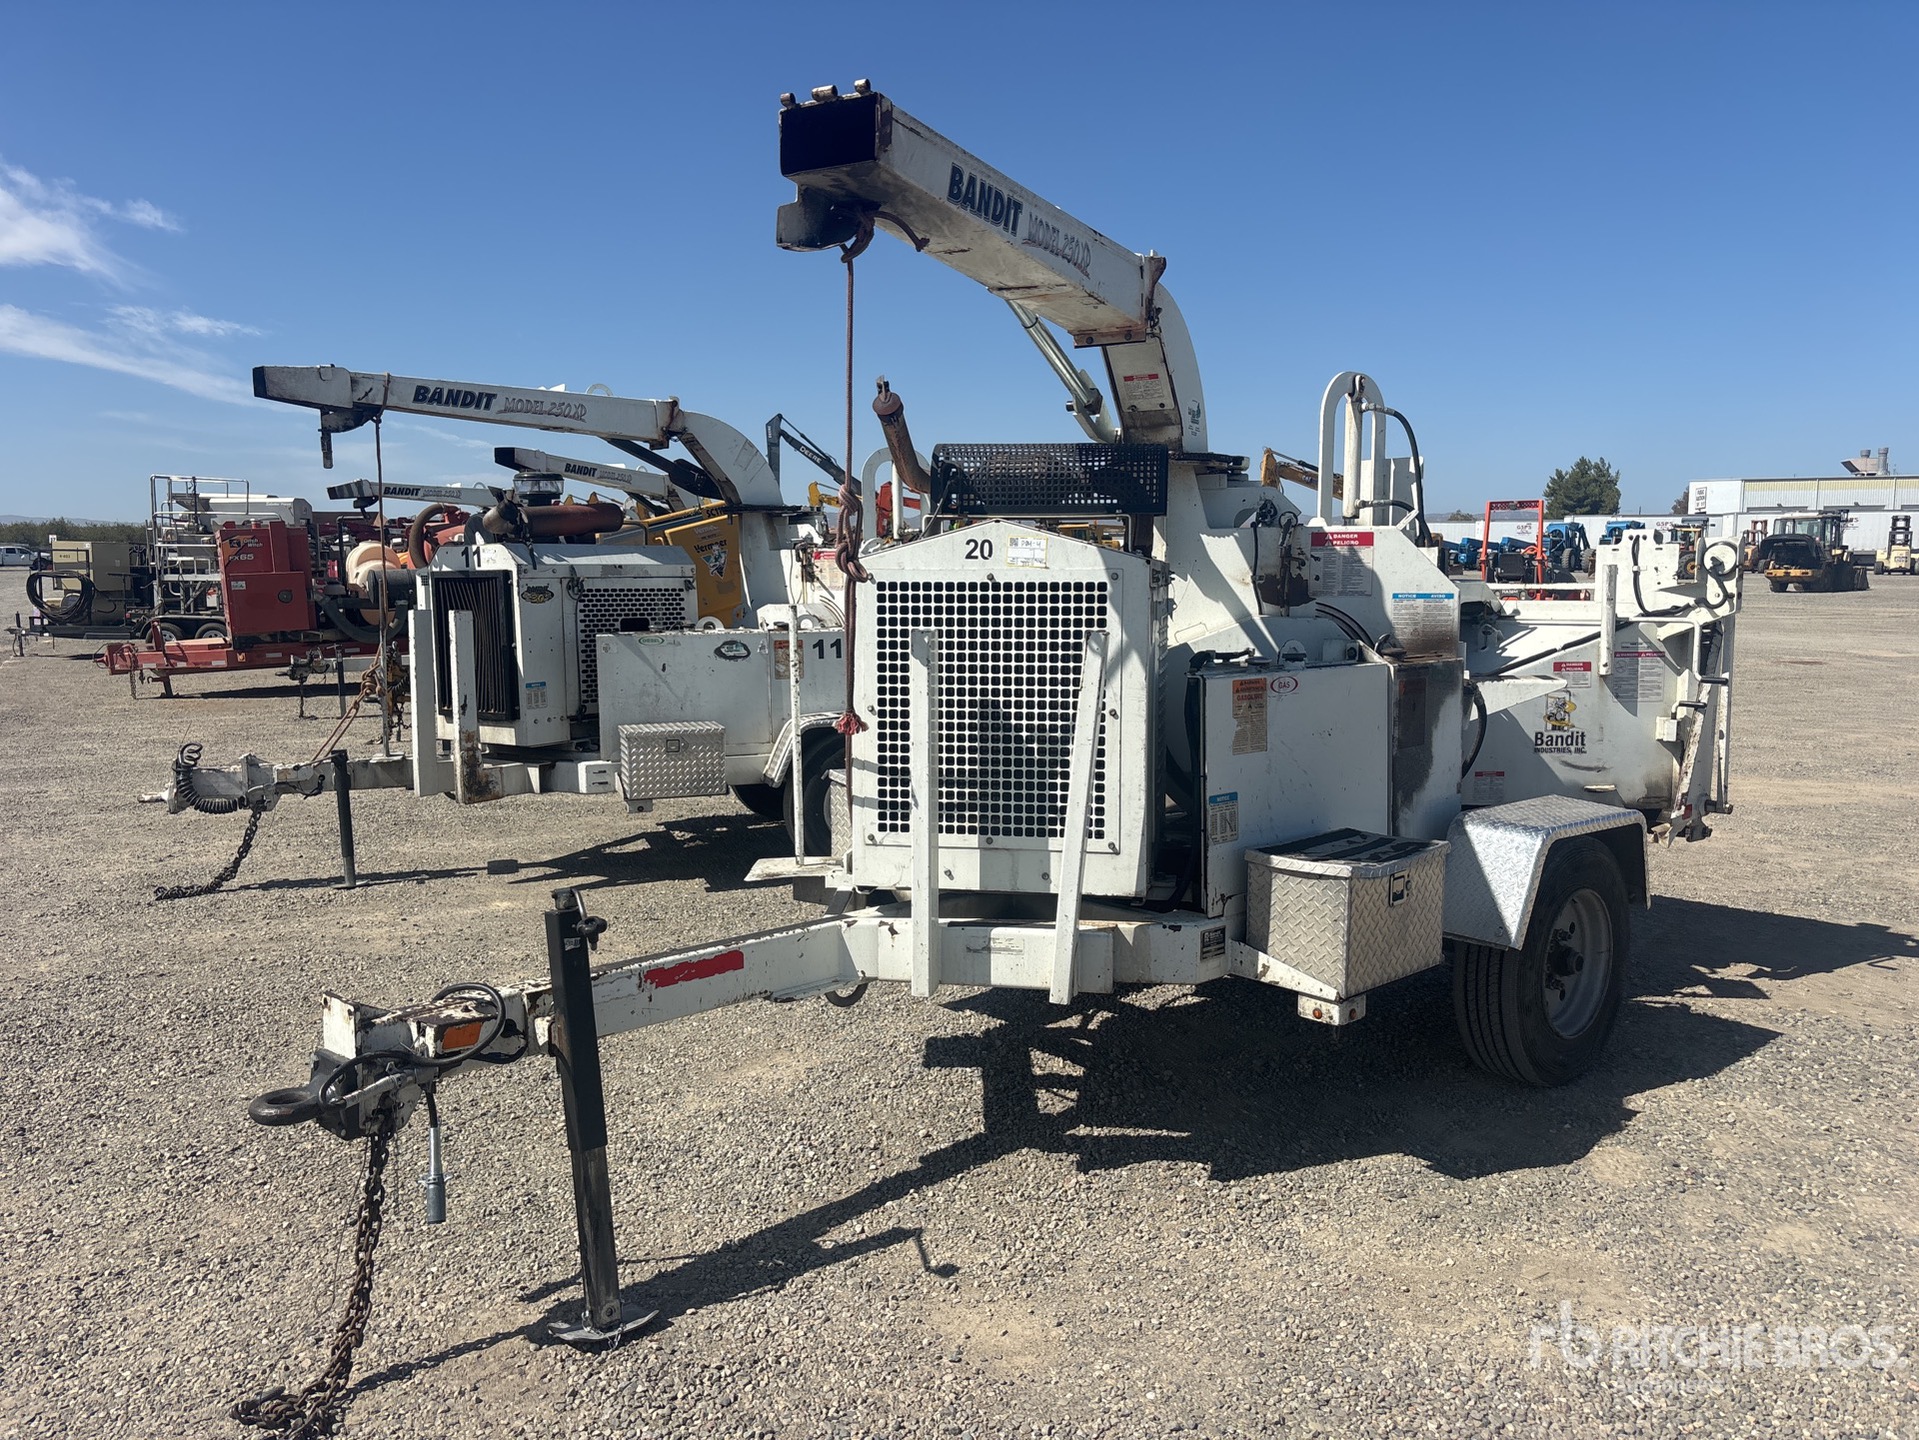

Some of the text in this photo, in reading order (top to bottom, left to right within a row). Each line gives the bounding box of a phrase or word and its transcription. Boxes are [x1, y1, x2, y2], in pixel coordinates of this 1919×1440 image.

[947, 162, 1023, 237] BANDIT
[1027, 211, 1060, 257] MODEL
[412, 385, 497, 411] BANDIT
[503, 396, 545, 415] MODEL
[800, 446, 822, 463] DEERE
[564, 463, 597, 477] BANDIT
[383, 486, 421, 497] BANDIT
[461, 546, 481, 567] 11
[965, 539, 993, 560] 20
[812, 638, 842, 659] 11
[1278, 681, 1291, 689] GAS
[1534, 731, 1586, 747] Bandit
